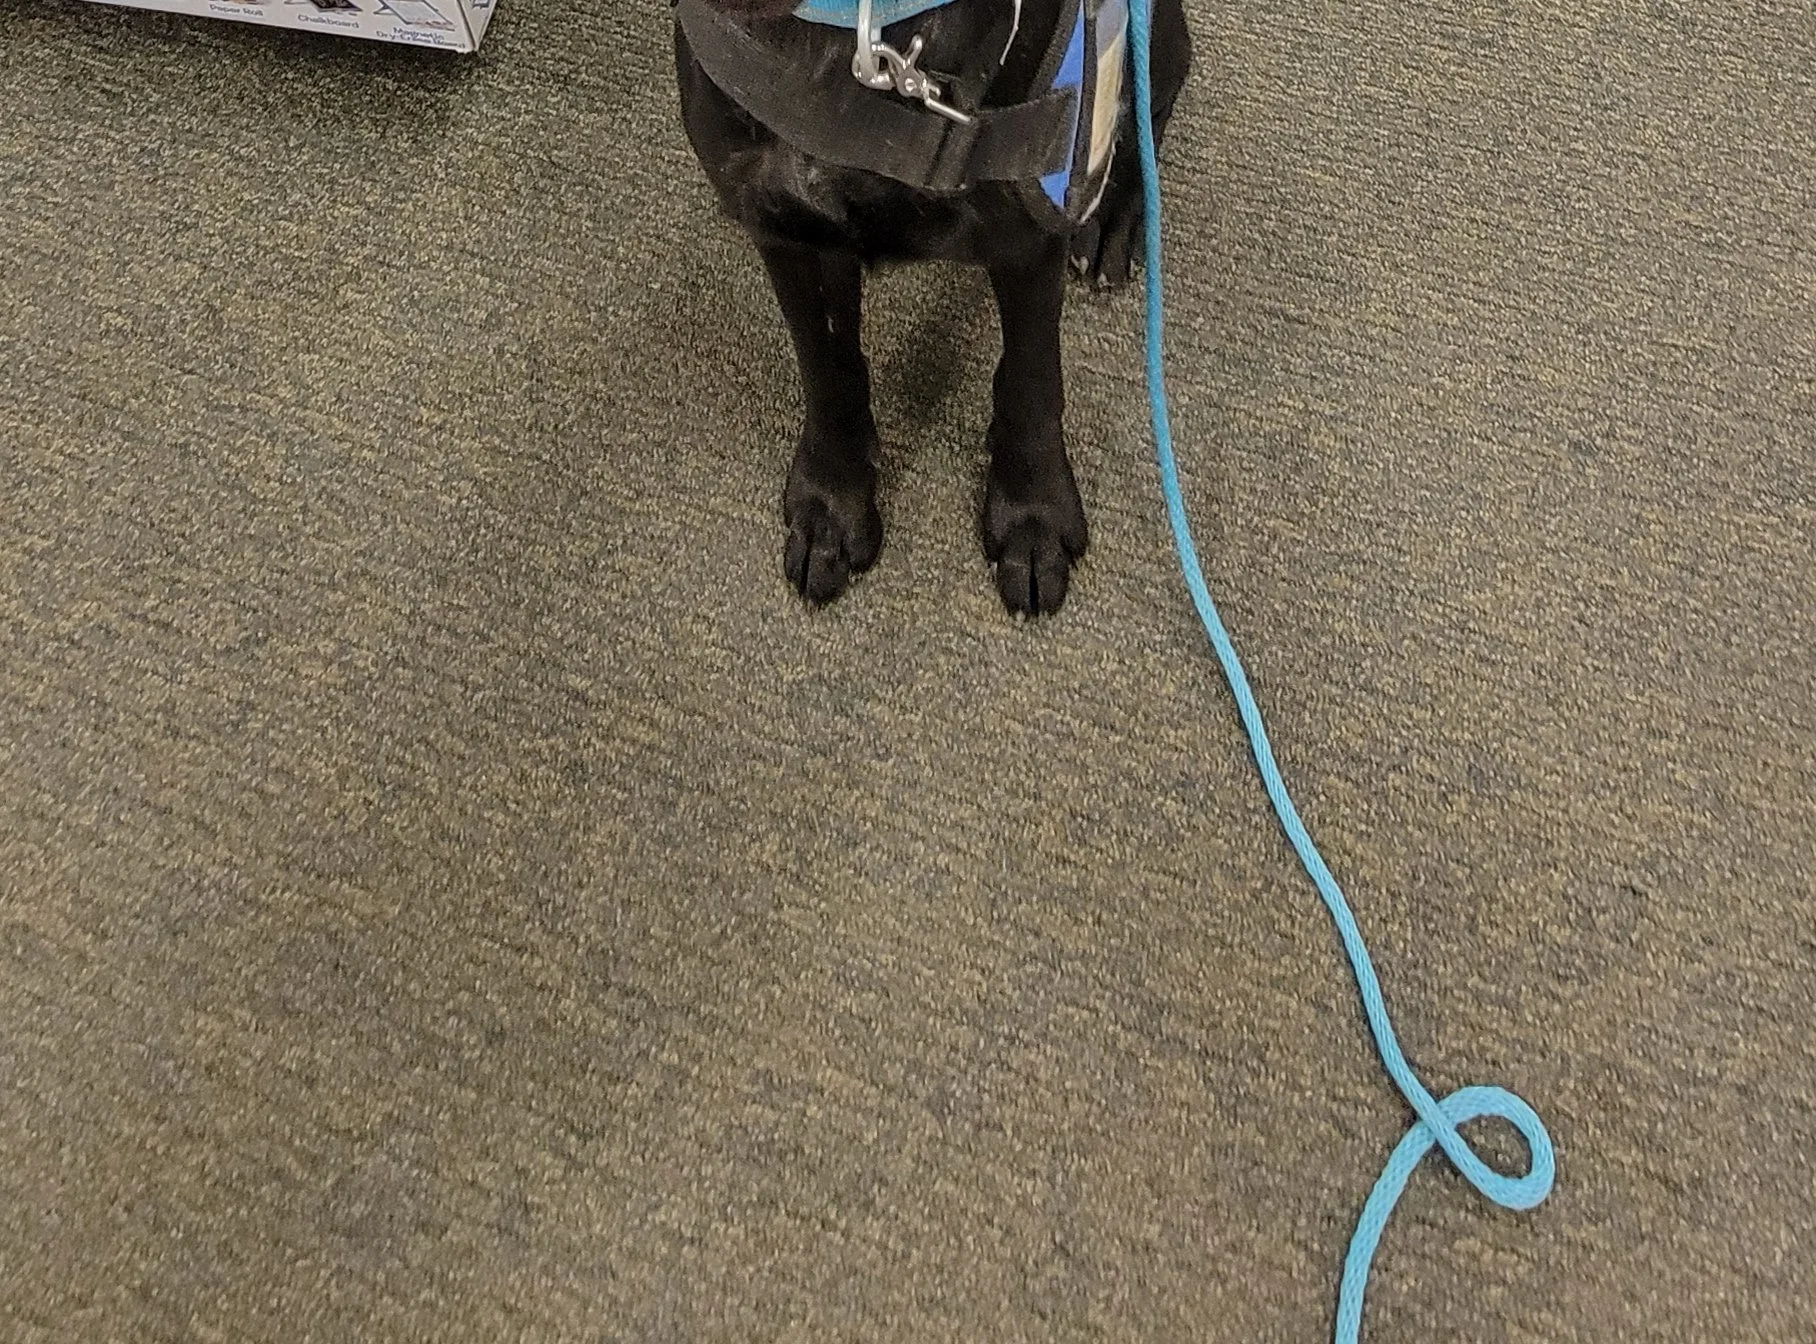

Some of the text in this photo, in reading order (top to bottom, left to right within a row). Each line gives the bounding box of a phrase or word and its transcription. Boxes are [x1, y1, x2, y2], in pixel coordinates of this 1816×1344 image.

[209, 3, 241, 16] Paper
[297, 14, 360, 30] Chalkboard
[392, 26, 445, 40] Magnetic
